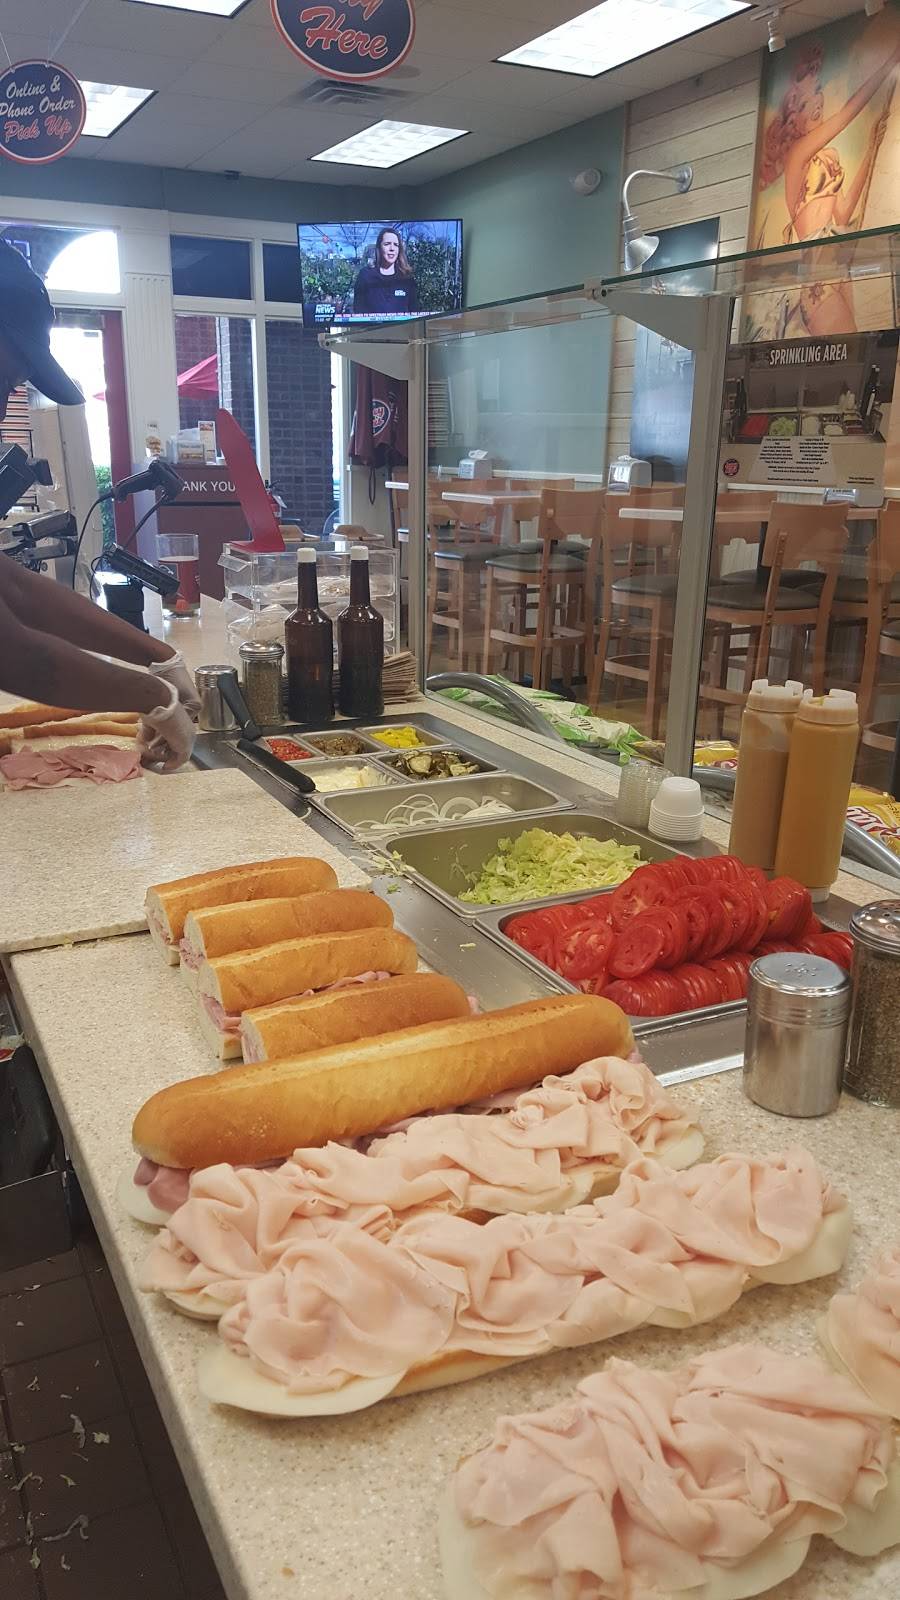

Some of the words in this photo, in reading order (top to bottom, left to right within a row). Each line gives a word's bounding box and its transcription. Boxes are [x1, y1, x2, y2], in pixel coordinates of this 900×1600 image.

[300, 5, 388, 60] Here
[6, 81, 46, 99] Online
[50, 75, 61, 93] &
[0, 102, 35, 118] Phone
[39, 95, 76, 113] Order
[4, 118, 41, 143] Pick
[44, 114, 72, 140] Up
[315, 306, 336, 314] NEWS
[769, 345, 821, 366] SPRINKLING
[823, 343, 848, 362] AREA
[182, 481, 208, 492] ANK
[210, 481, 236, 492] YOU
